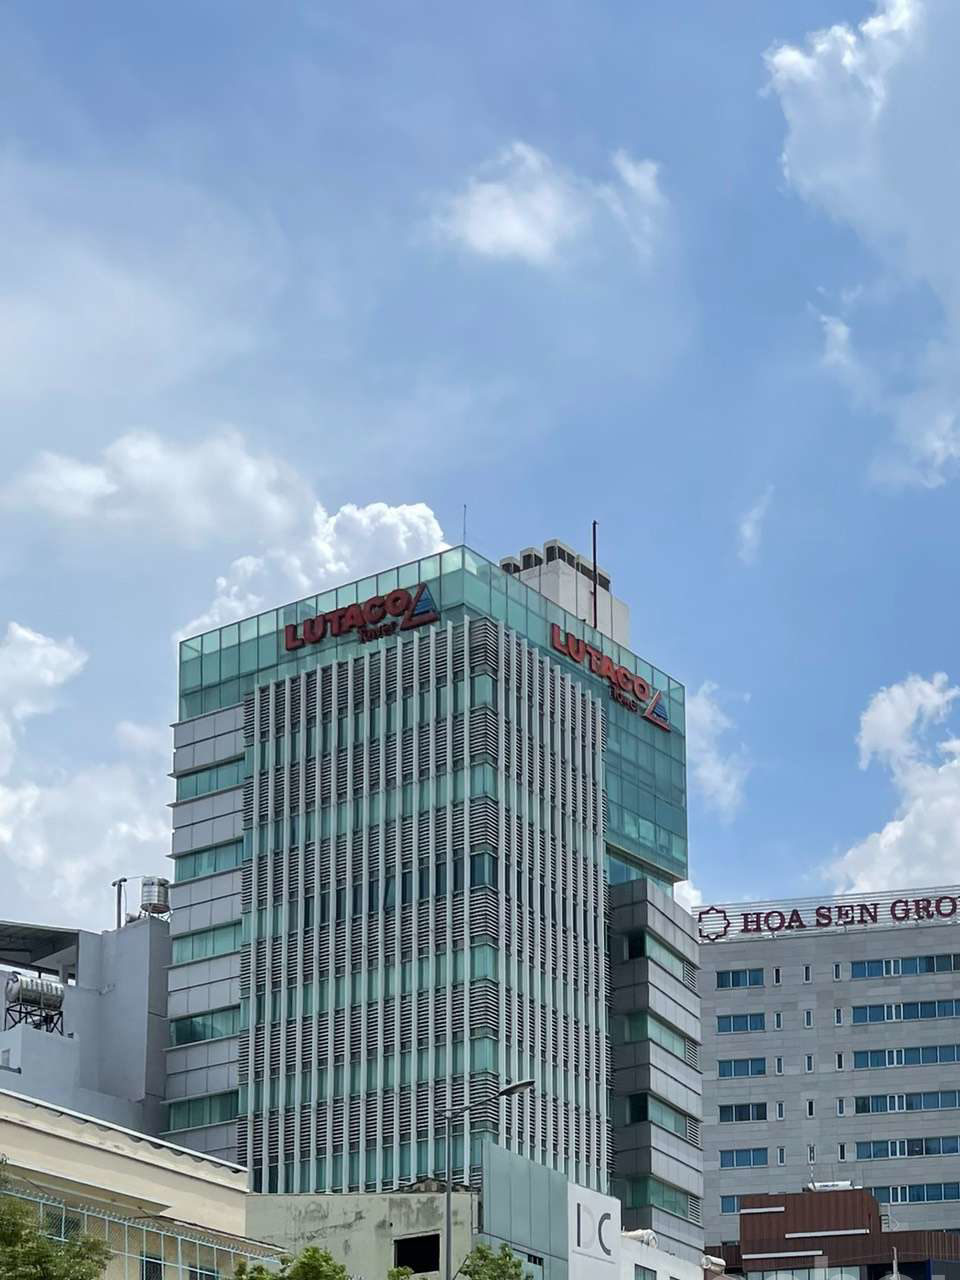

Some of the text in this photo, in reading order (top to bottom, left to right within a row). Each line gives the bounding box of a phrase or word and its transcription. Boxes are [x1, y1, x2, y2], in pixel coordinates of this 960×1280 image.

[284, 588, 412, 651] LUTACO
[551, 622, 651, 702] LUTACO
[740, 909, 807, 933] HOA
[815, 902, 880, 927] SEN
